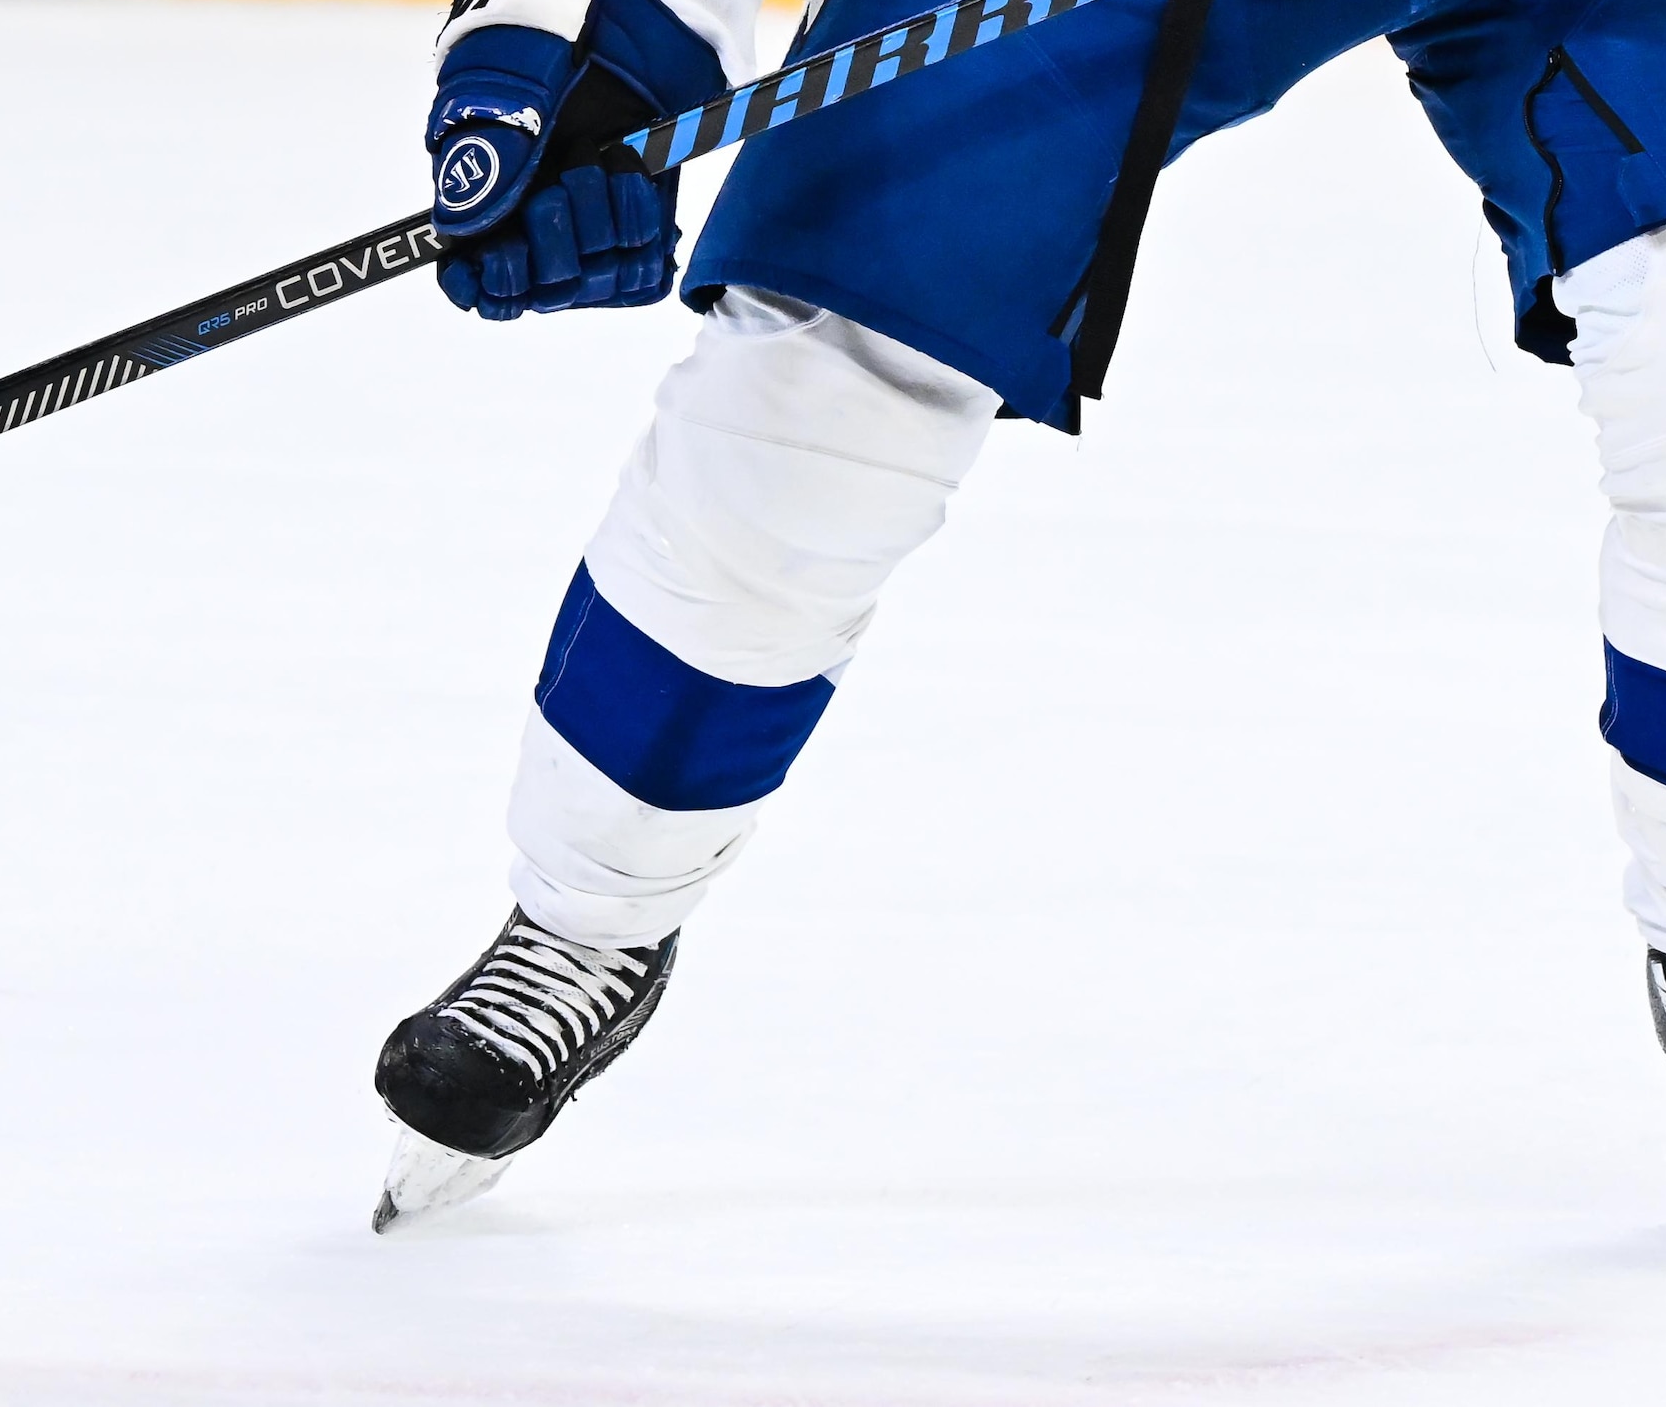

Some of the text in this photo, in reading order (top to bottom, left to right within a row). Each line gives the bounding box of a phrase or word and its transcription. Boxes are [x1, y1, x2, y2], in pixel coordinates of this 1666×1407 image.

[198, 223, 444, 336] QR5 PRO COVER
